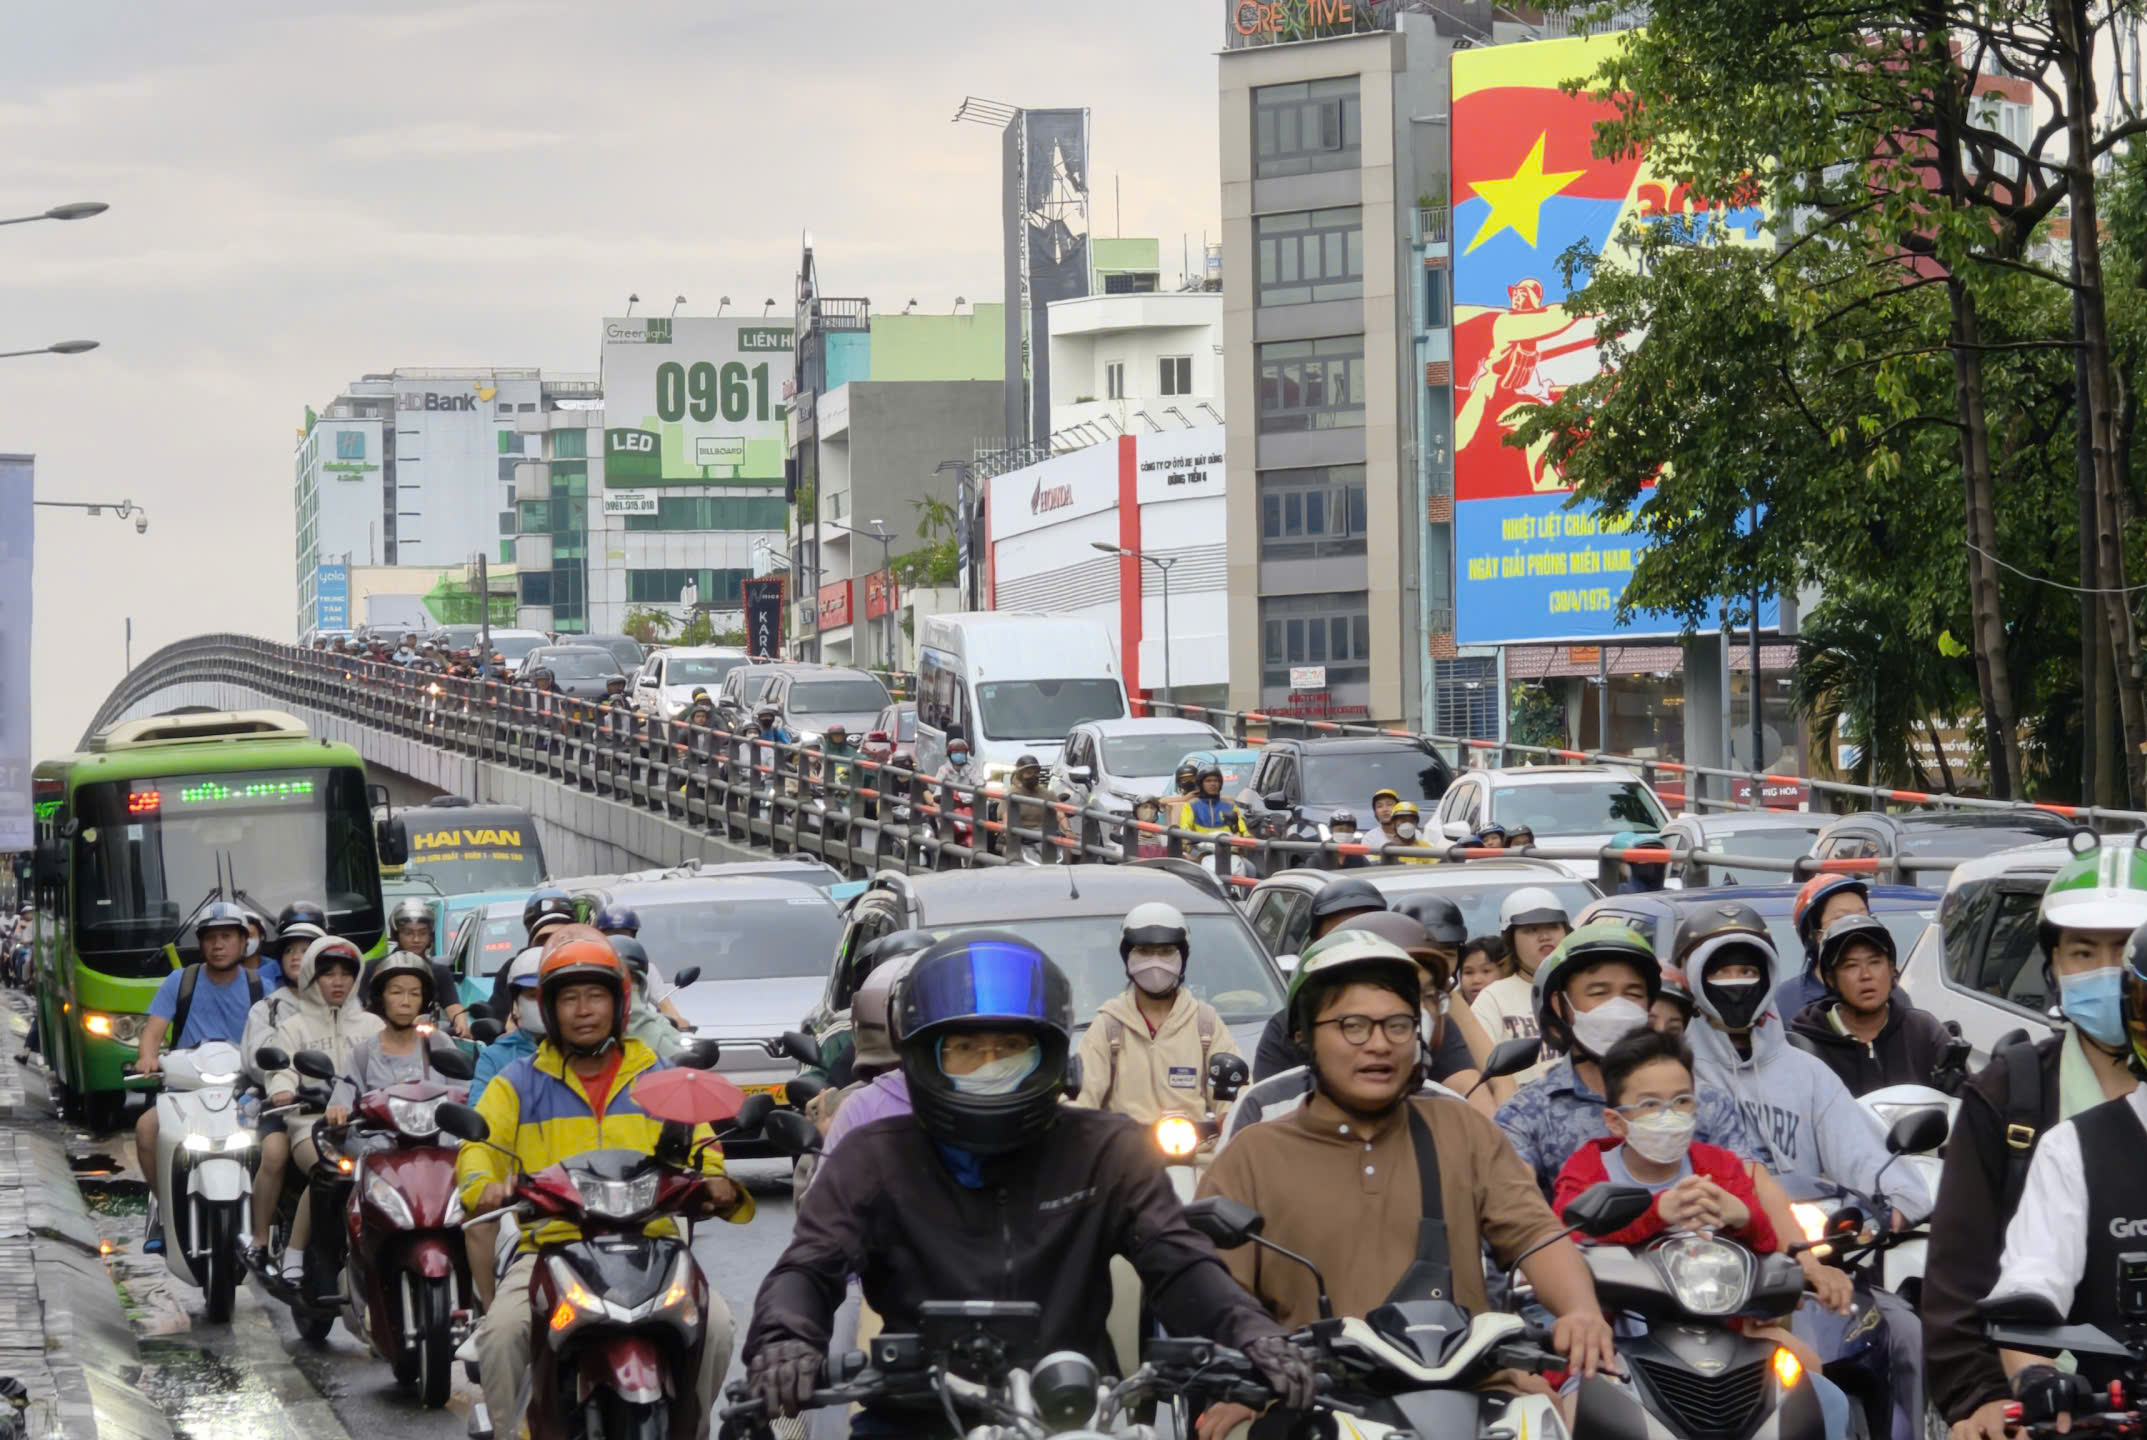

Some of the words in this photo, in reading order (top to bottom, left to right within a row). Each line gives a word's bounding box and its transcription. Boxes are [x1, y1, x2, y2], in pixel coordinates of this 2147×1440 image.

[743, 331, 777, 348] LIÊN
[781, 334, 794, 347] H
[395, 392, 477, 412] HDBank
[612, 433, 653, 452] LED
[1039, 484, 1074, 513] HONDA
[1527, 548, 1567, 577] PHÓNG
